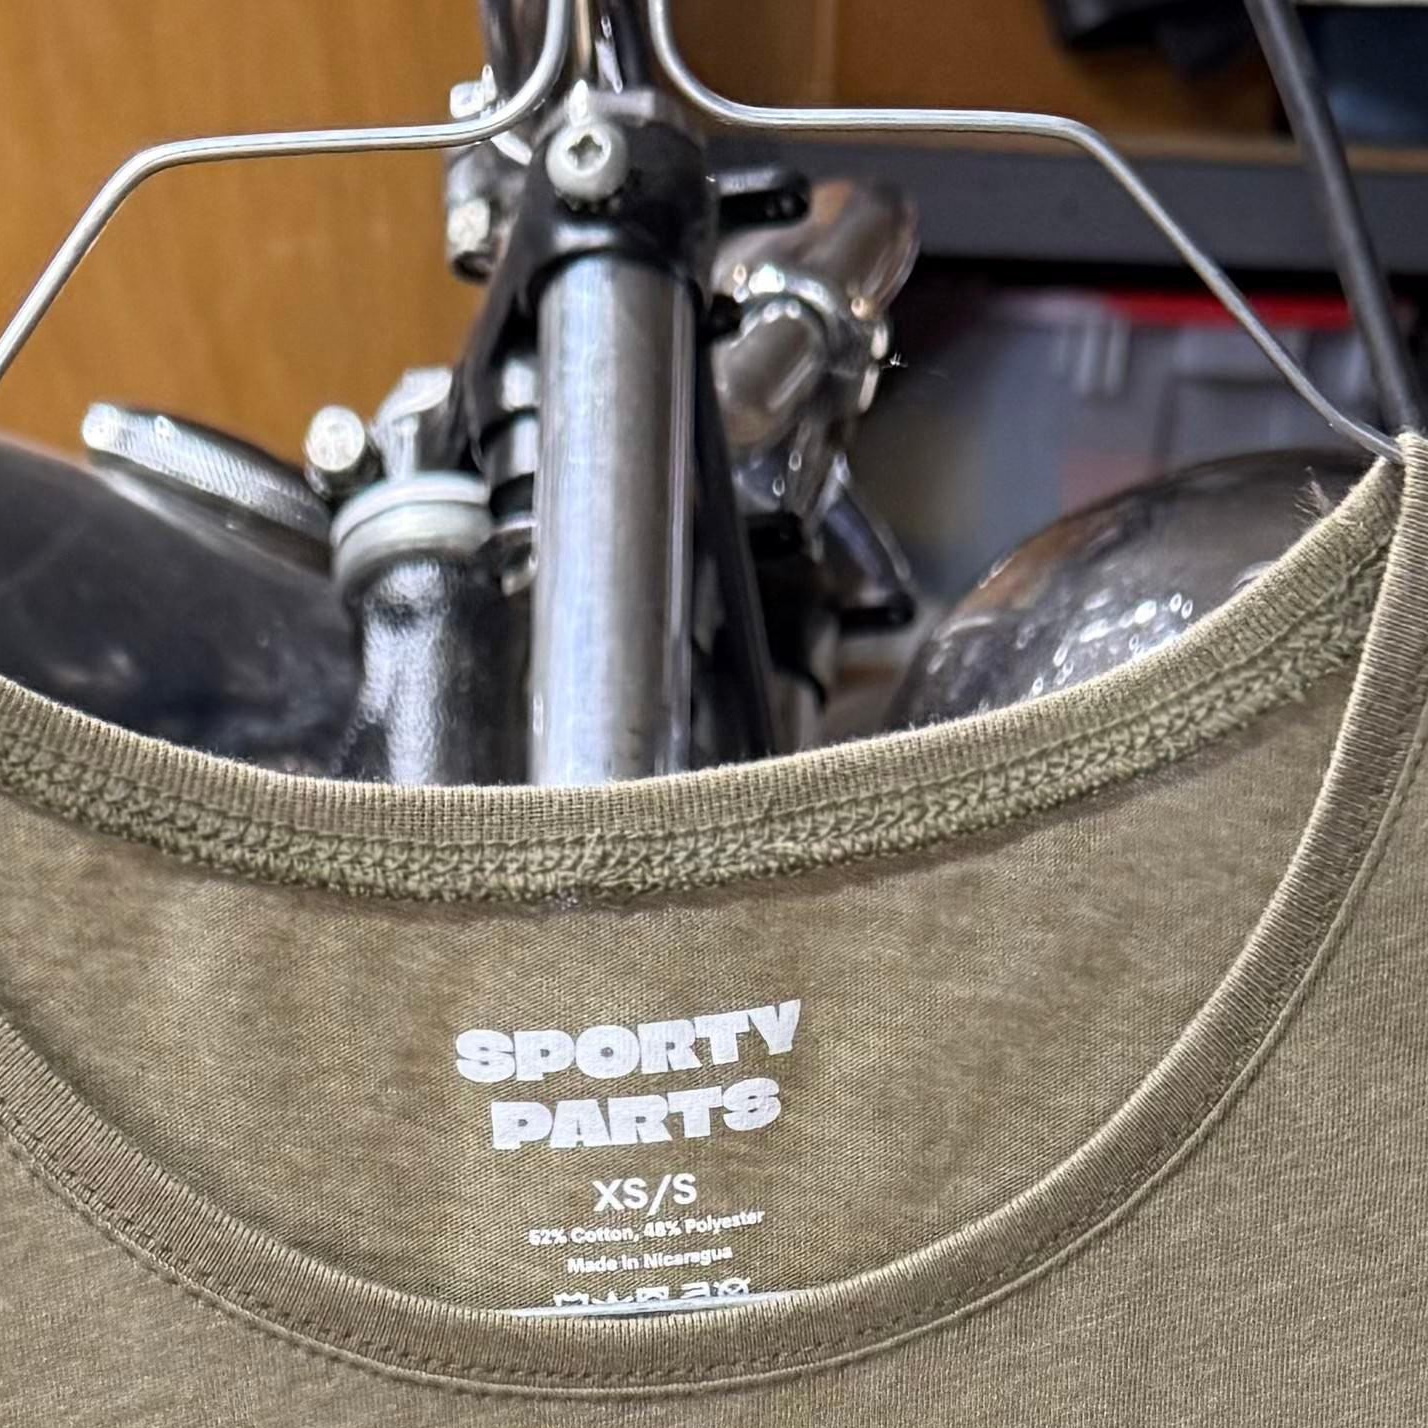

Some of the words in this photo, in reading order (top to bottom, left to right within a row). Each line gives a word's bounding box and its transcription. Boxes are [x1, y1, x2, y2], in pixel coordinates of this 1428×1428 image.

[455, 999, 801, 1083] SPORTY
[490, 1077, 782, 1150] PARTS
[592, 1172, 698, 1216] XS/S
[571, 1224, 640, 1245] Cotton,
[643, 1219, 682, 1239] 48%
[685, 1210, 766, 1236] Polyester
[566, 1255, 619, 1275] Made
[621, 1254, 639, 1271] in
[643, 1246, 734, 1270] Nicaragua
